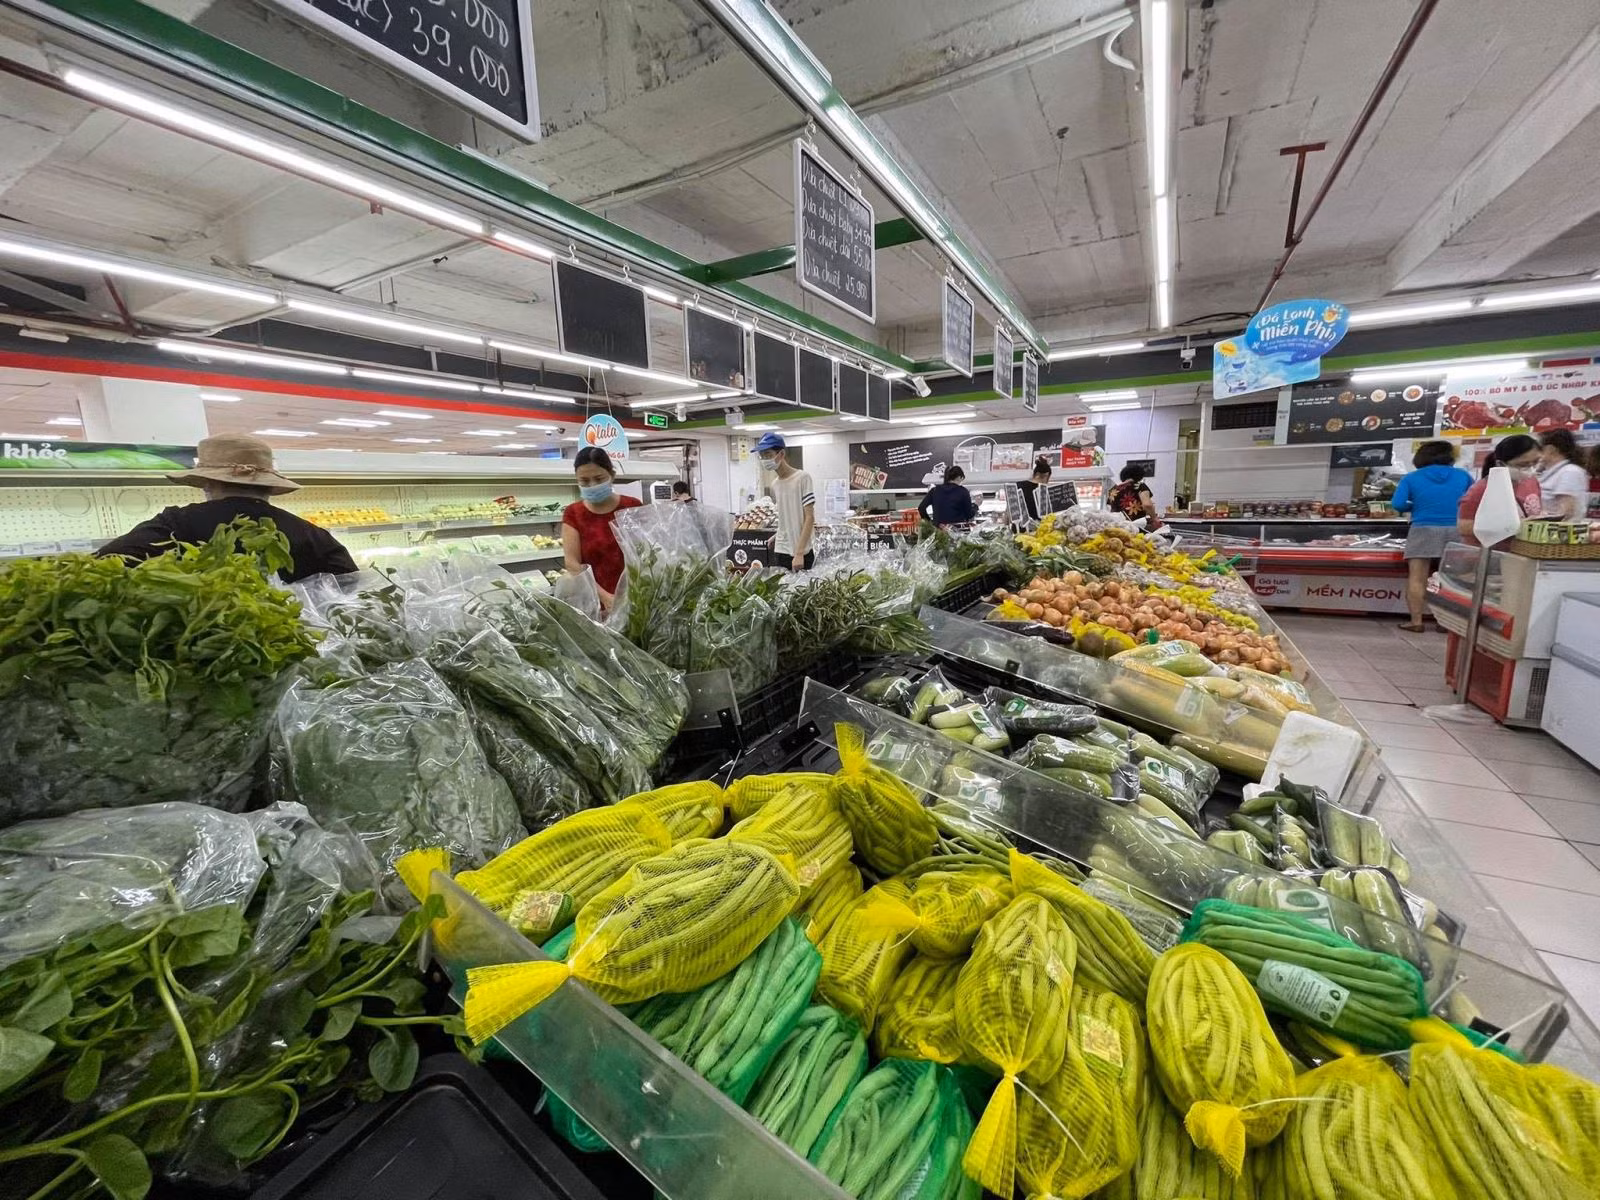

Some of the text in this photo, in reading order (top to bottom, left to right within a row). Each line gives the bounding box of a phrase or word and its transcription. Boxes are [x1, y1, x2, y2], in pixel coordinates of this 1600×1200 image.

[409, 7, 510, 96] 39.000
[1283, 306, 1315, 322] Lạnh
[1349, 588, 1401, 600] NGON
